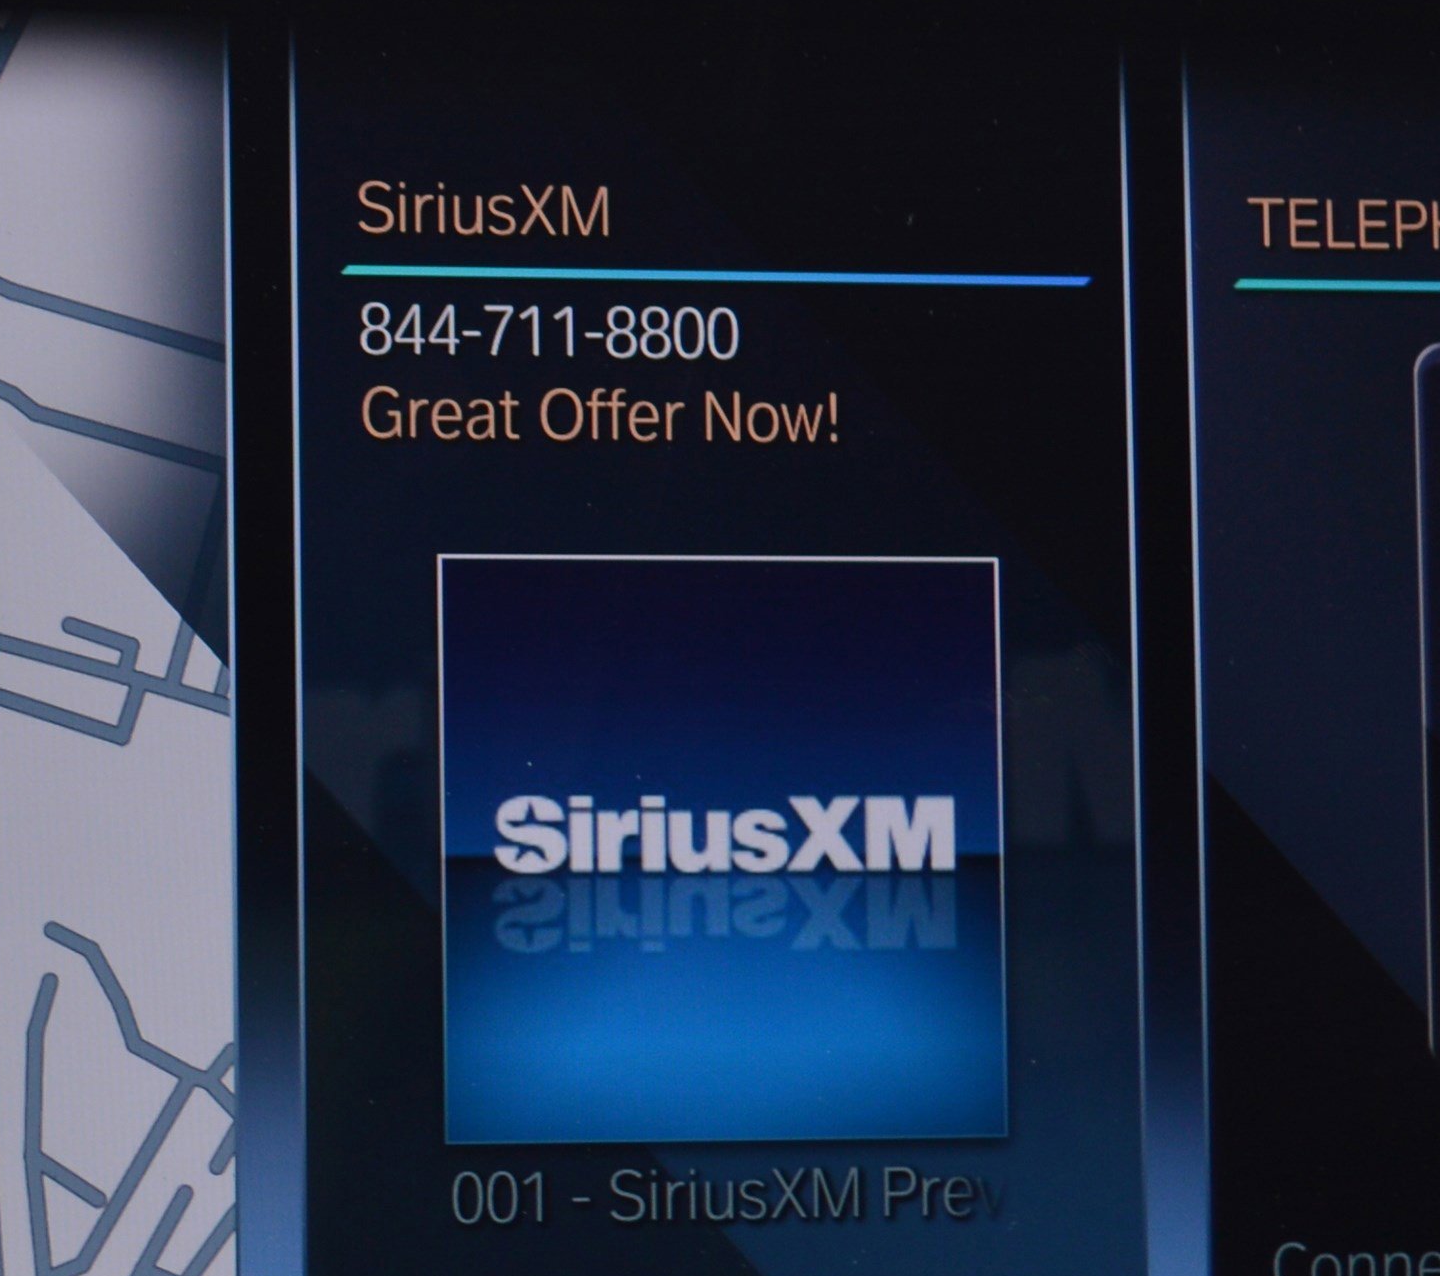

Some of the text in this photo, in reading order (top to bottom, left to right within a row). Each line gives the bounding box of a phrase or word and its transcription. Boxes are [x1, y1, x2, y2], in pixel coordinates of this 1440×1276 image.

[358, 180, 609, 237] SiriusXM
[359, 301, 740, 360] 844-711-8800
[361, 385, 838, 443] Great Offer Now!
[493, 794, 957, 874] SiriusXM
[452, 1170, 543, 1225] 001
[610, 1166, 861, 1222] SiriusXM
